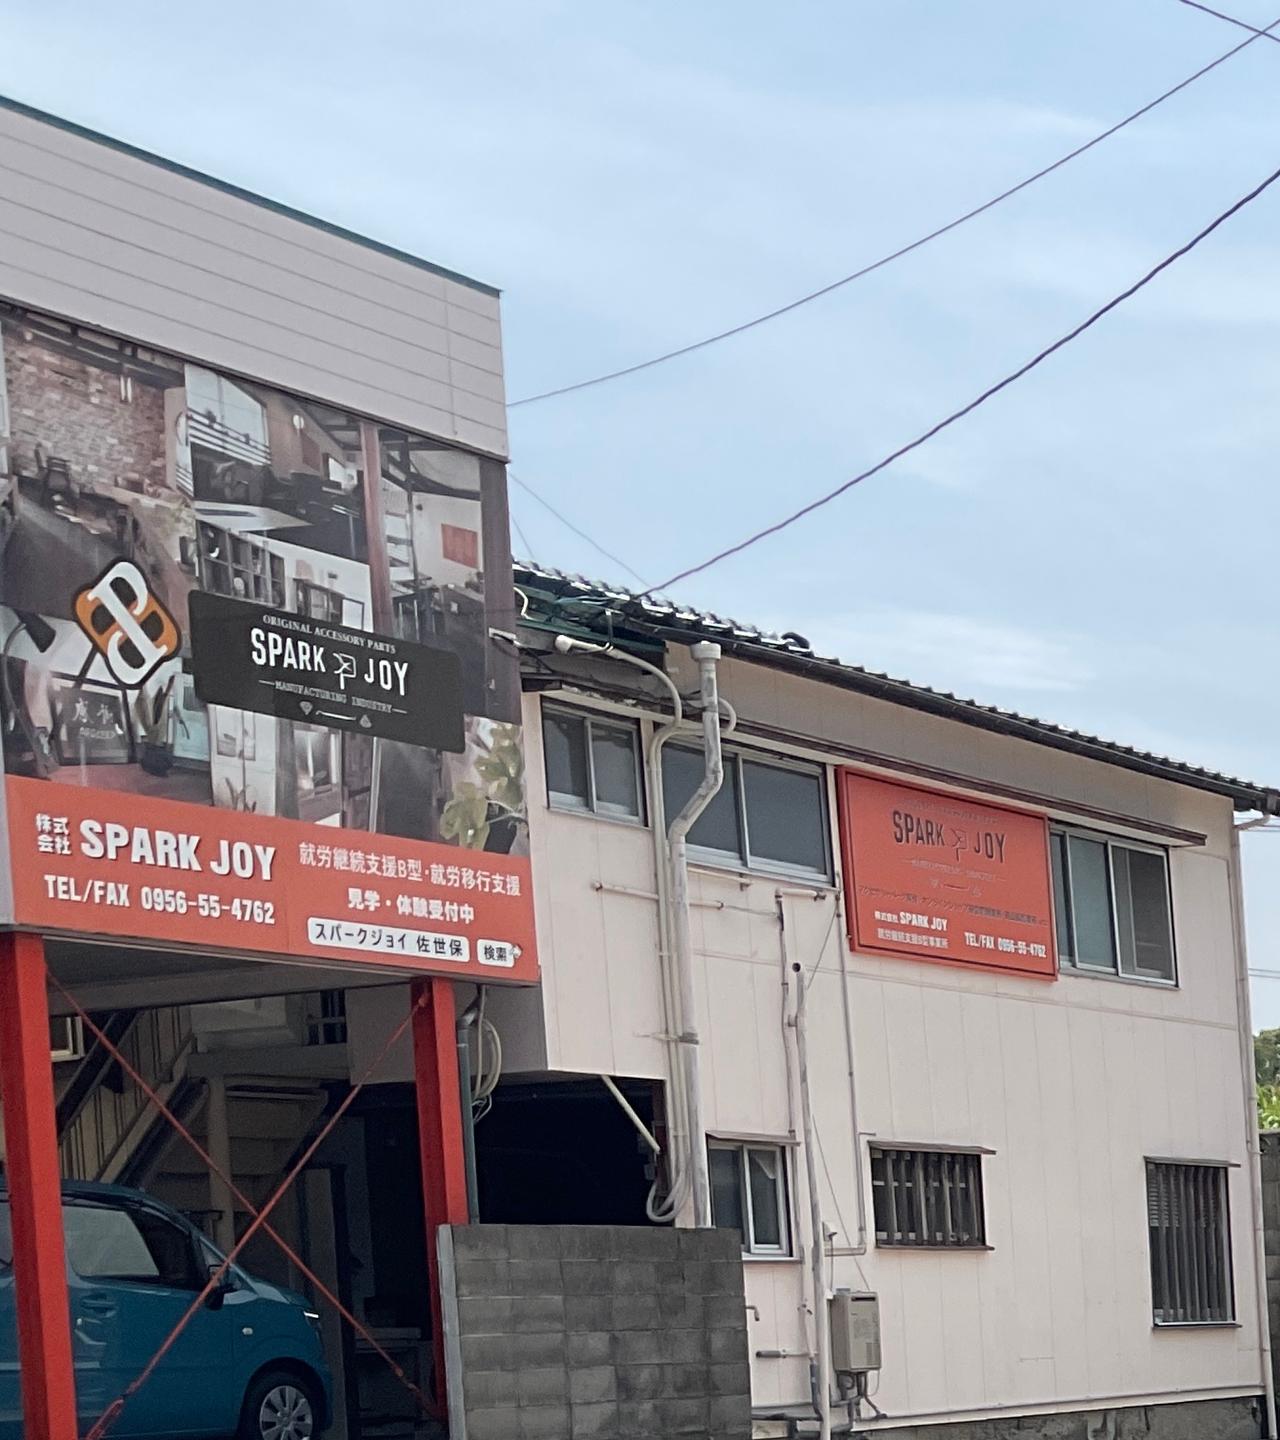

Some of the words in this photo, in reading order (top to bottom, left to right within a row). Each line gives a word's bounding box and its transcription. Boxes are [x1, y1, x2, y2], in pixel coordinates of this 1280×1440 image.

[262, 614, 312, 634] ORIGINAL
[314, 627, 367, 648] ACCESSORY
[367, 639, 396, 654] PARTS
[251, 628, 326, 673] SPARK
[364, 658, 409, 696] JOY
[35, 813, 70, 835] 株式
[892, 809, 945, 847] SPARK
[974, 831, 1005, 864] JOY
[37, 834, 71, 855] 会社
[79, 819, 202, 872] SPARK
[210, 839, 275, 881] JOY
[44, 874, 130, 908] TEL/FAX
[140, 886, 275, 924] 0956-55-4762
[348, 888, 475, 924] 見学・体験受付中
[899, 911, 928, 927] SPARK
[931, 918, 948, 931] JOY
[314, 923, 408, 949] スパークジョイ
[416, 935, 463, 957] 佐世保
[483, 944, 508, 962] 検索
